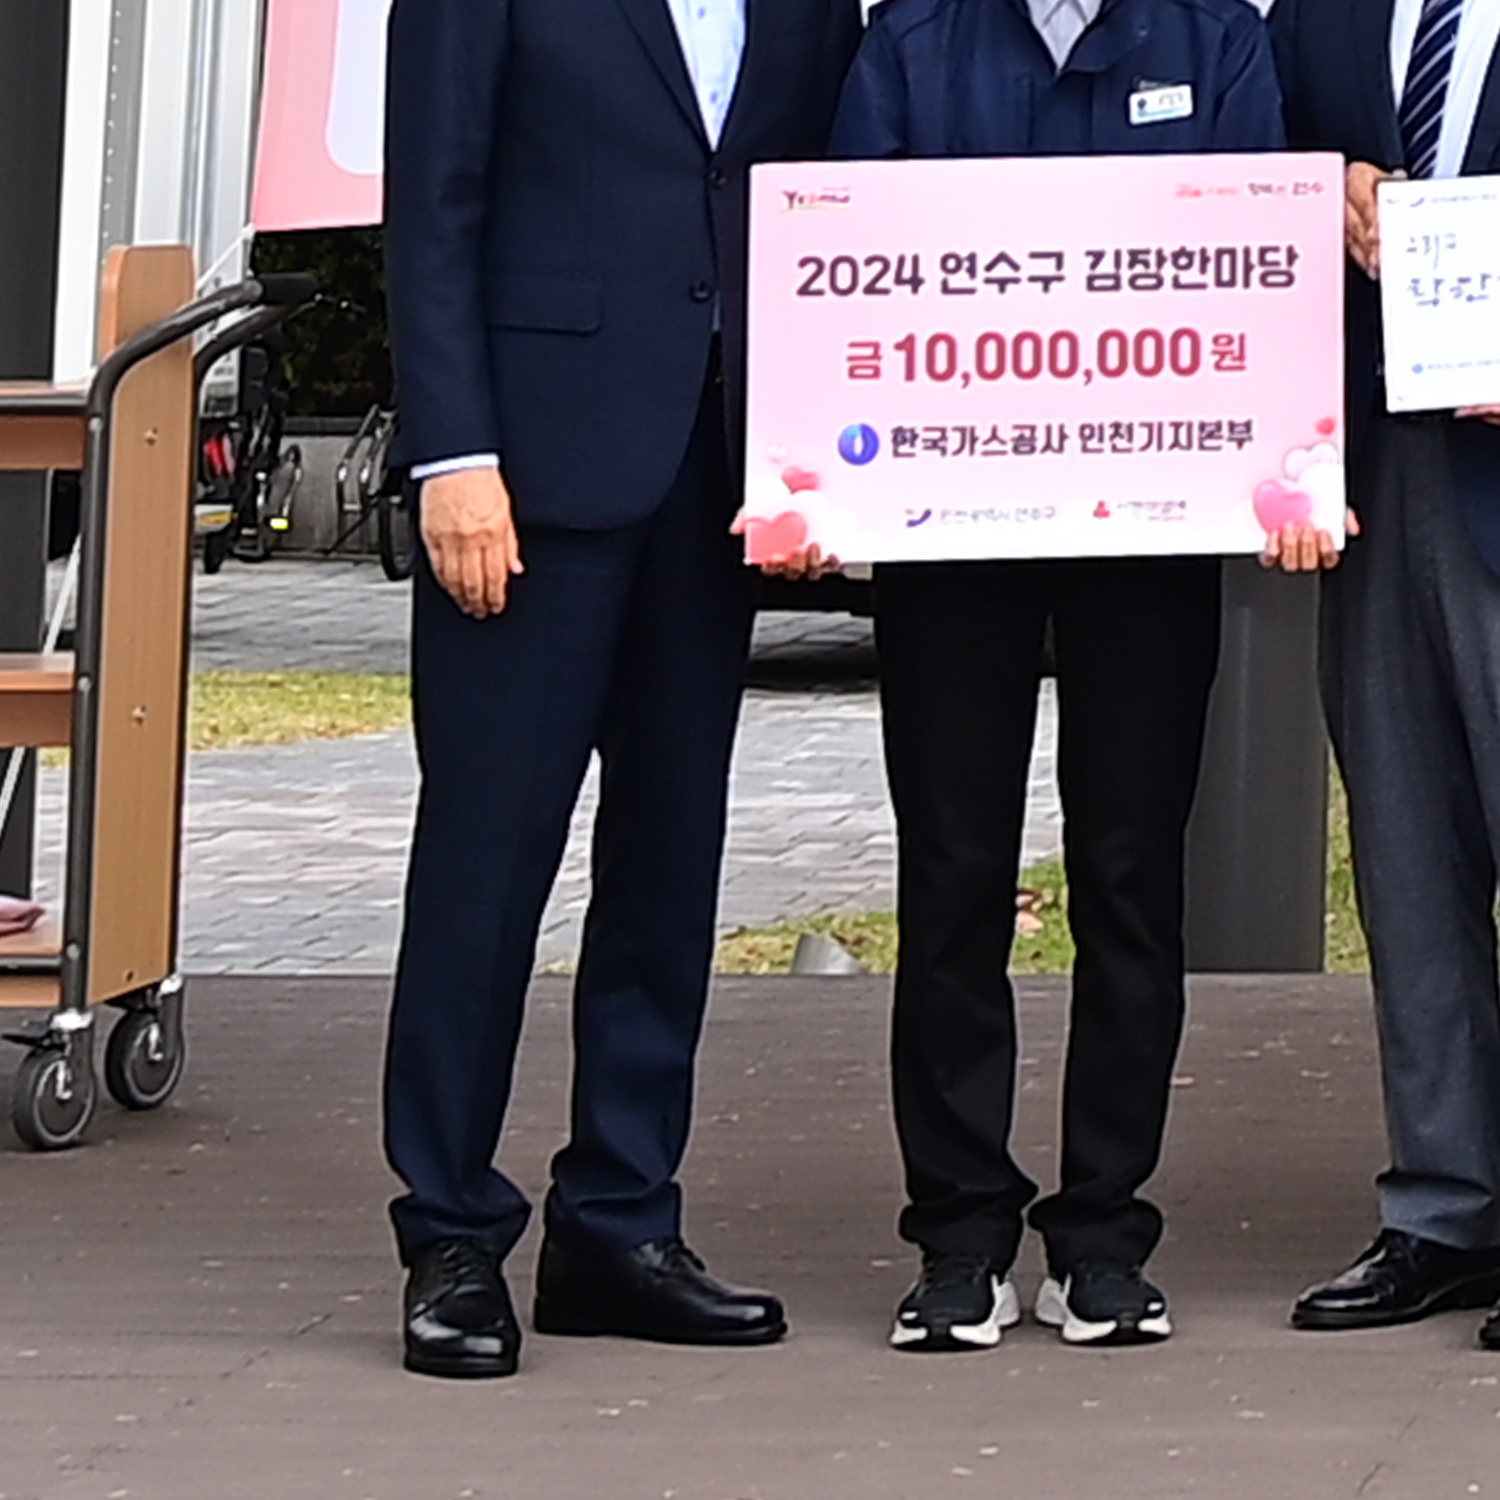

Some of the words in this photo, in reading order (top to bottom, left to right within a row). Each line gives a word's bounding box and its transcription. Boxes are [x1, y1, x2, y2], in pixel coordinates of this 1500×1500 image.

[795, 252, 926, 297] 2024
[939, 250, 1066, 295] 연수구
[1084, 244, 1300, 293] 김장한마당
[891, 421, 1069, 459] 한국가스공사
[1077, 418, 1254, 453] 인천기지본부
